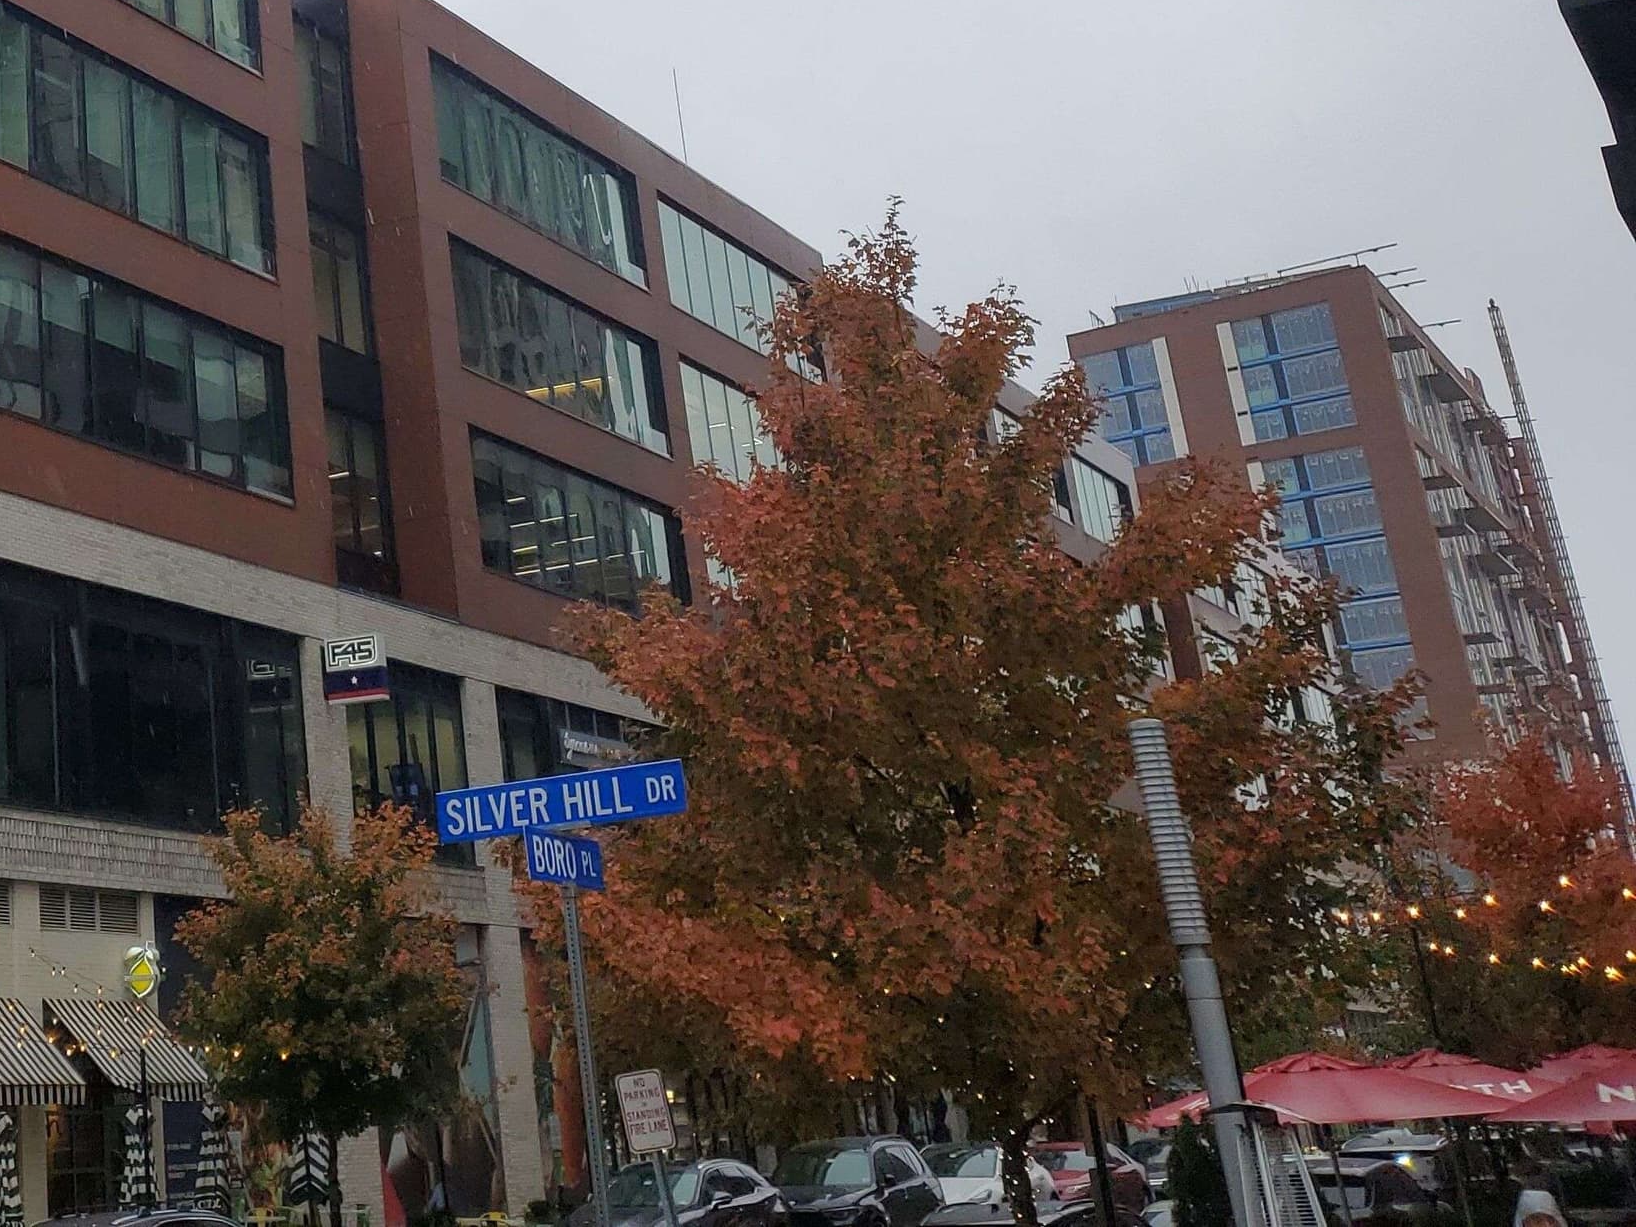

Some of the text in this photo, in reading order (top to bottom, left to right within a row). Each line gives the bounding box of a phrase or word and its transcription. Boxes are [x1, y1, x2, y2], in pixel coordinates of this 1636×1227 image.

[327, 636, 376, 667] F45
[446, 774, 677, 836] SILVER HILL DR
[532, 834, 598, 879] BORO PL
[624, 1087, 661, 1101] PARKING
[627, 1107, 666, 1122] STANDING
